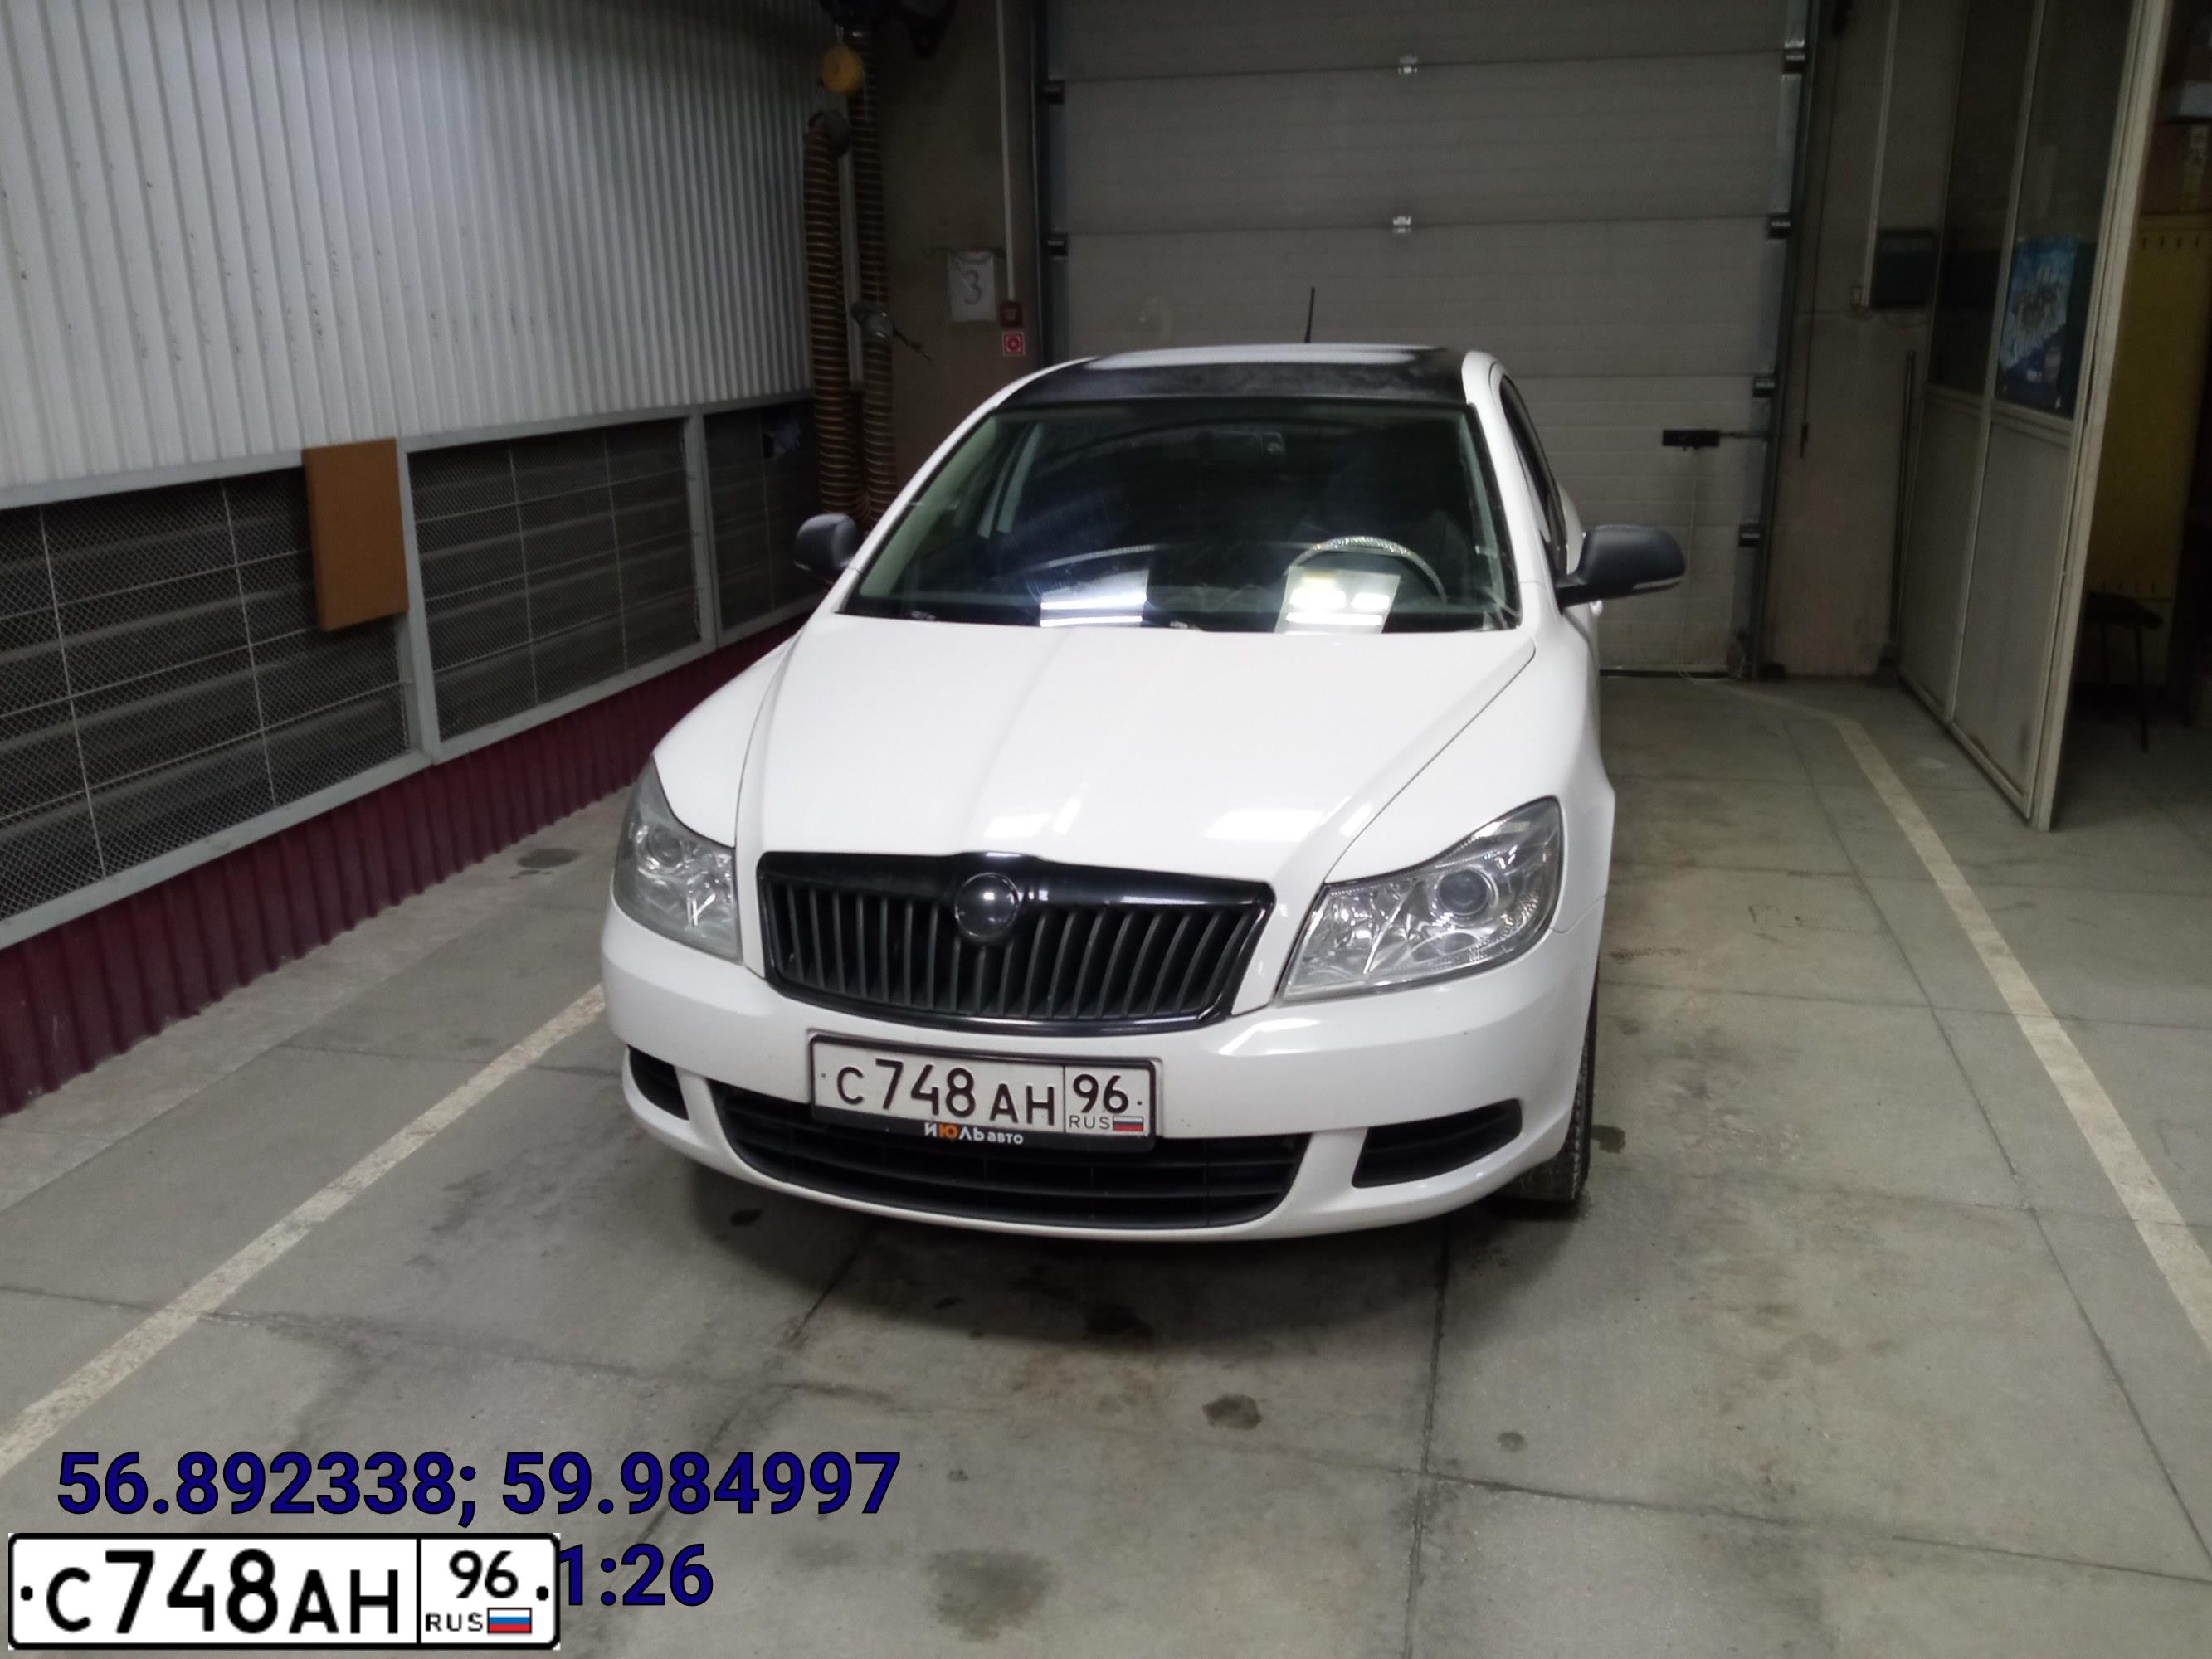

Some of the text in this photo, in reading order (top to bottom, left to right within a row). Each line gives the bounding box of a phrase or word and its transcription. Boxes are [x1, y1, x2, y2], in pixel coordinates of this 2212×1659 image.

[964, 269, 982, 305] 3
[1072, 1073, 1129, 1115] 96
[1069, 1115, 1111, 1131] RUS
